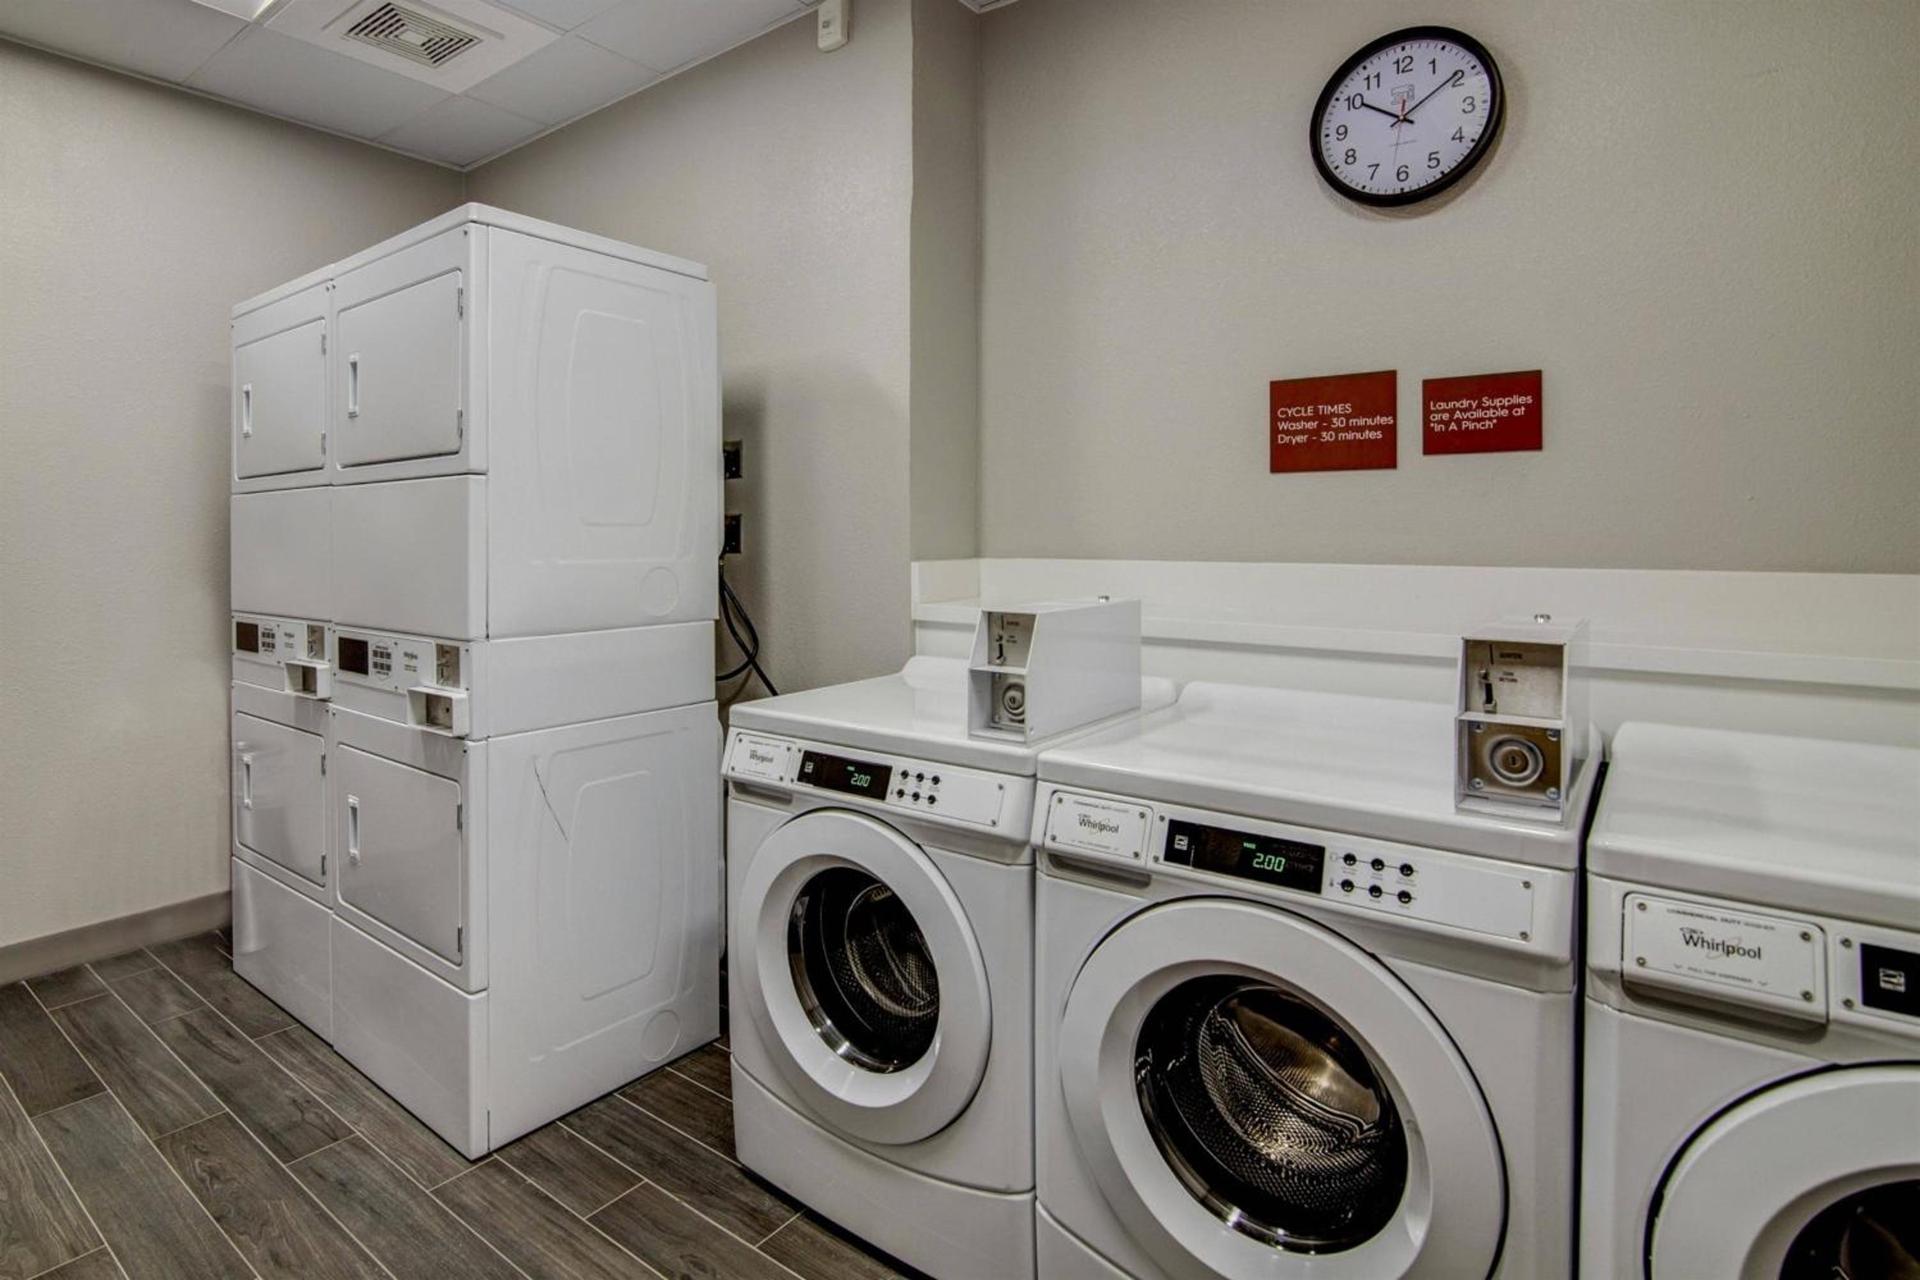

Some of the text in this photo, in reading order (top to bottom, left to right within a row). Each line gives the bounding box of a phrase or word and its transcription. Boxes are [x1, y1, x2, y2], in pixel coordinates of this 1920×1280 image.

[1392, 55, 1414, 74] 12
[1428, 58, 1437, 74] 1
[1363, 72, 1381, 90] 11
[1451, 69, 1465, 87] 2
[1344, 93, 1364, 111] 10
[1462, 96, 1476, 113] 3
[1336, 125, 1348, 141] 9
[1451, 126, 1465, 143] 4
[1344, 148, 1357, 165] 8
[1427, 151, 1441, 169] 5
[1367, 163, 1380, 180] 7
[1396, 164, 1409, 182] 6
[1277, 403, 1352, 418] CYCLE TIMES
[1430, 394, 1533, 410] Laundry Supplies
[1430, 405, 1526, 422] are Available at
[1277, 419, 1319, 431] Washer
[1331, 417, 1346, 428] 30
[1349, 415, 1394, 427] minutes
[1448, 421, 1458, 432] A
[1277, 433, 1308, 445] Dryer
[1320, 431, 1335, 442] 30
[1338, 430, 1383, 441] minutes
[1078, 817, 1119, 834] Whirlpool
[1252, 853, 1286, 873] 2.00
[1682, 933, 1762, 960] Whirlpool
